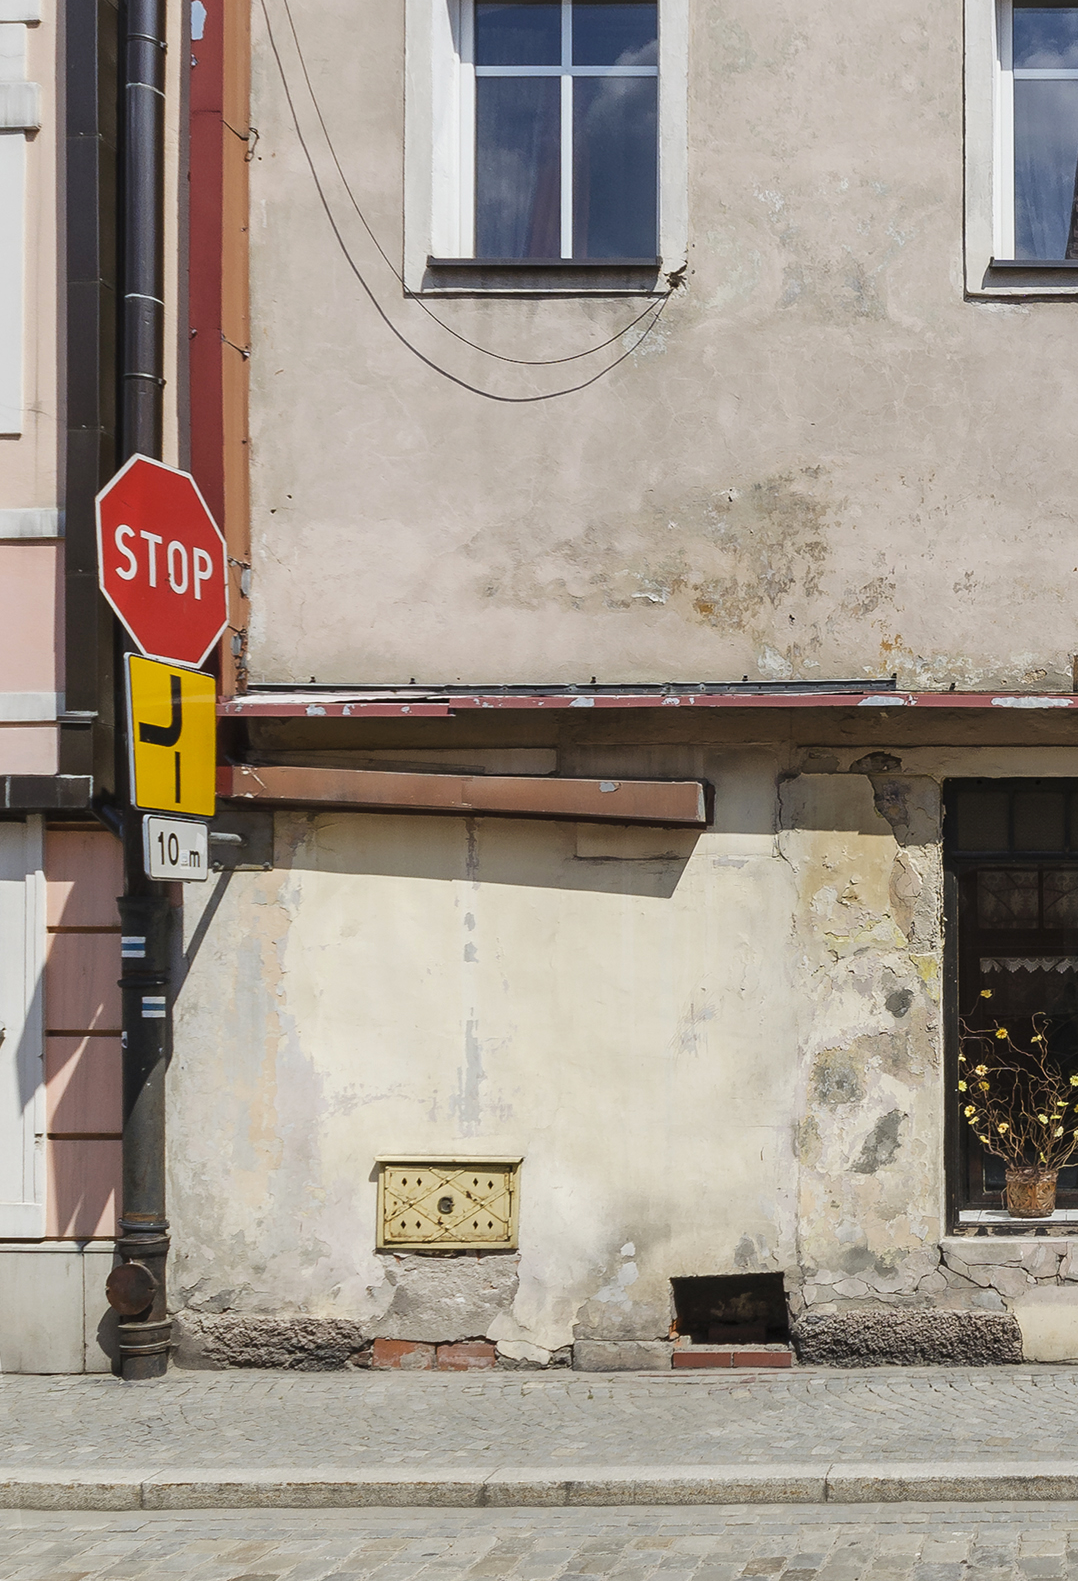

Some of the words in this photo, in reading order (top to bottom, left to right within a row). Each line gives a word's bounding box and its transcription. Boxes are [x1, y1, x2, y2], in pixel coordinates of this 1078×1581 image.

[114, 524, 213, 600] STOP
[157, 831, 179, 866] 10
[189, 850, 200, 867] m
